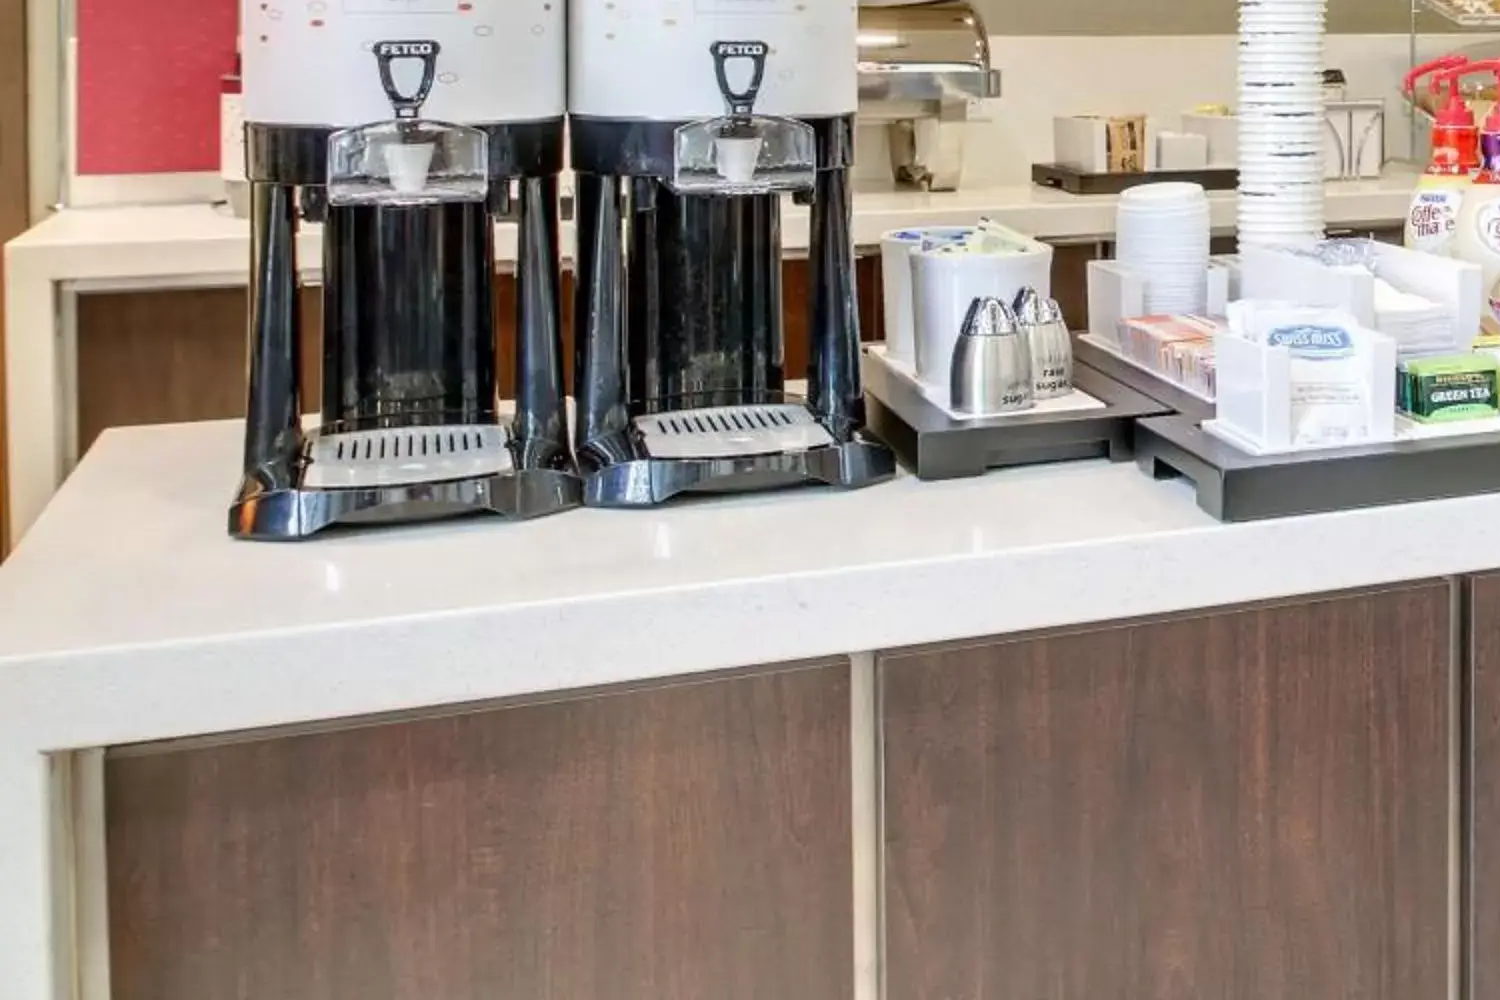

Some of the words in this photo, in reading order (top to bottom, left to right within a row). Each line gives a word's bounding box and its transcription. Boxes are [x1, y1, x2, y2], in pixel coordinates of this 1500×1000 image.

[380, 43, 432, 55] FETCO
[719, 43, 763, 55] FETCO
[1043, 366, 1065, 377] raw
[1430, 390, 1468, 403] GREEN
[1469, 387, 1491, 400] TEA
